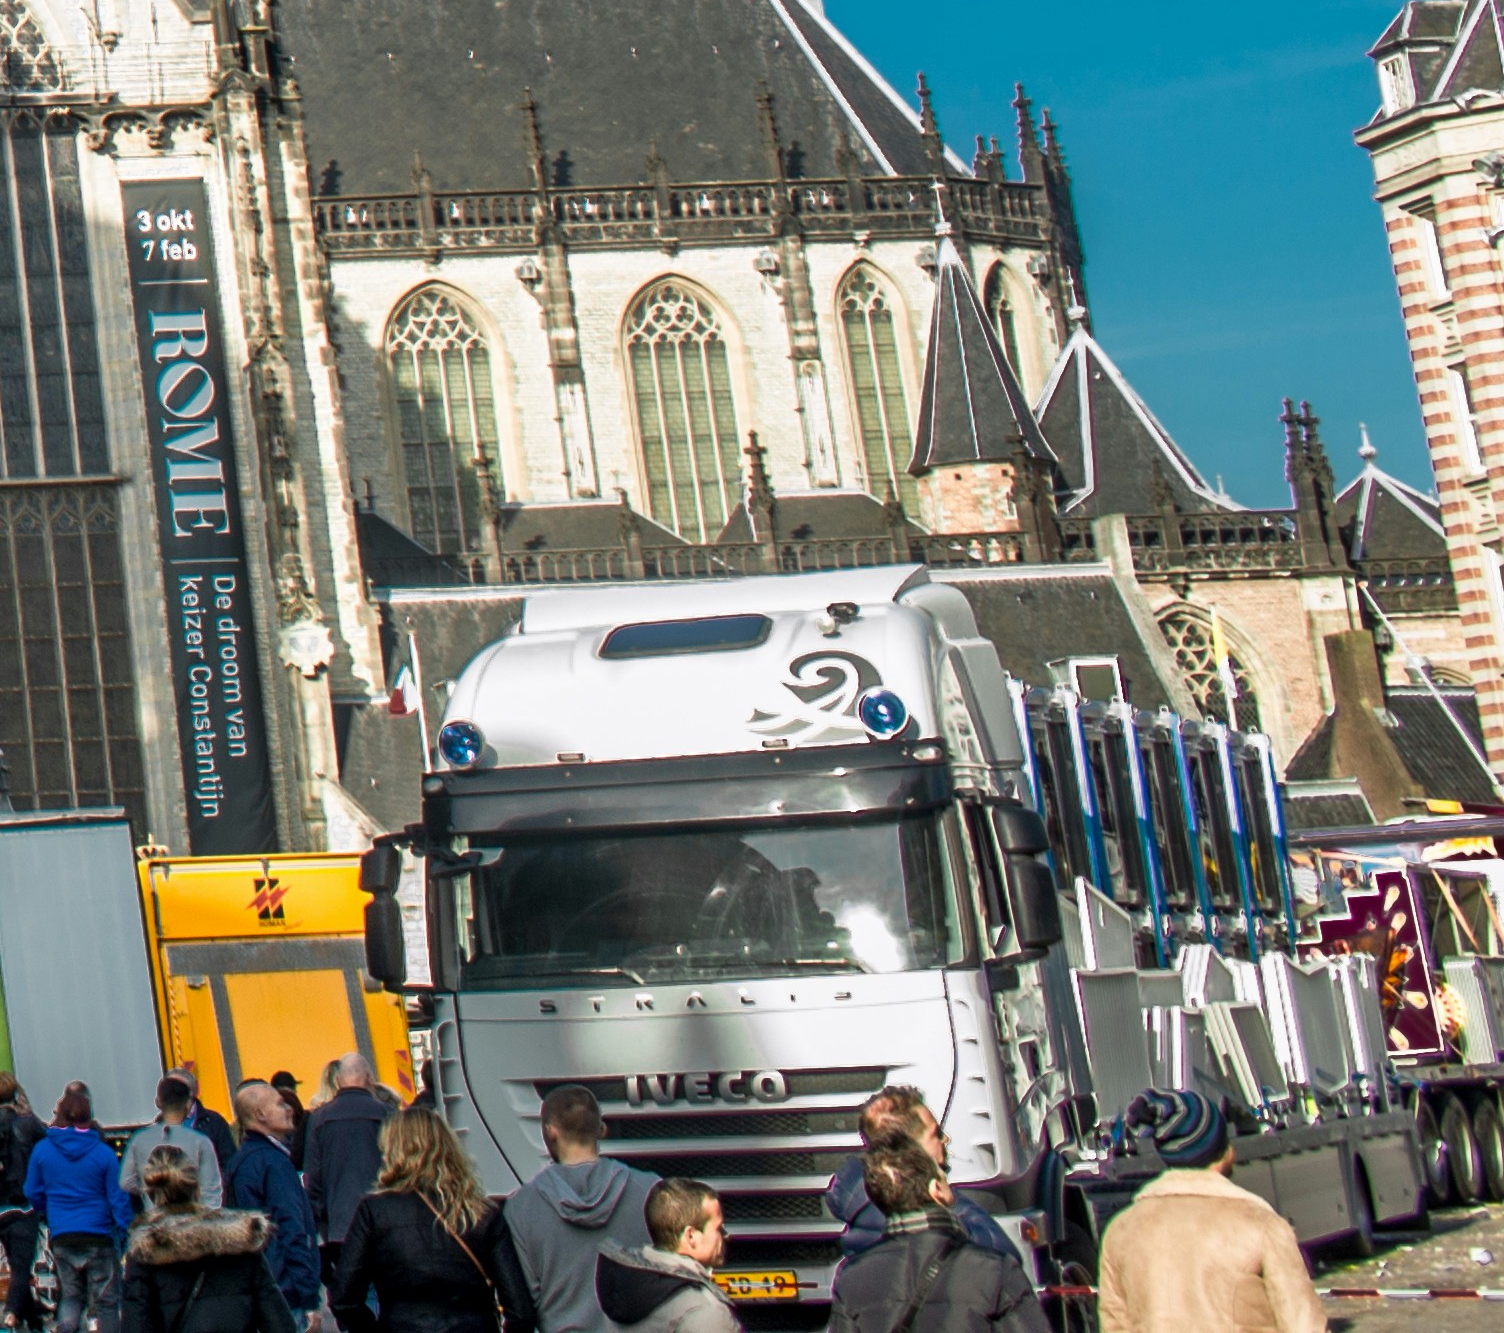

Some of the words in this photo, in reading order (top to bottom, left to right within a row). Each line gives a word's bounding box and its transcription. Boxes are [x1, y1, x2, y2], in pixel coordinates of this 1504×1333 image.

[136, 209, 152, 232] 3
[156, 208, 194, 231] okt
[140, 240, 155, 261] 7
[160, 237, 197, 261] feb
[148, 308, 230, 537] ROME
[212, 574, 236, 610] De
[179, 574, 206, 660] keizer
[217, 615, 241, 703] droom
[188, 662, 224, 818] Constantijn
[225, 708, 247, 757] van
[539, 991, 852, 1013] STRALIS
[627, 1070, 790, 1106] IVECO
